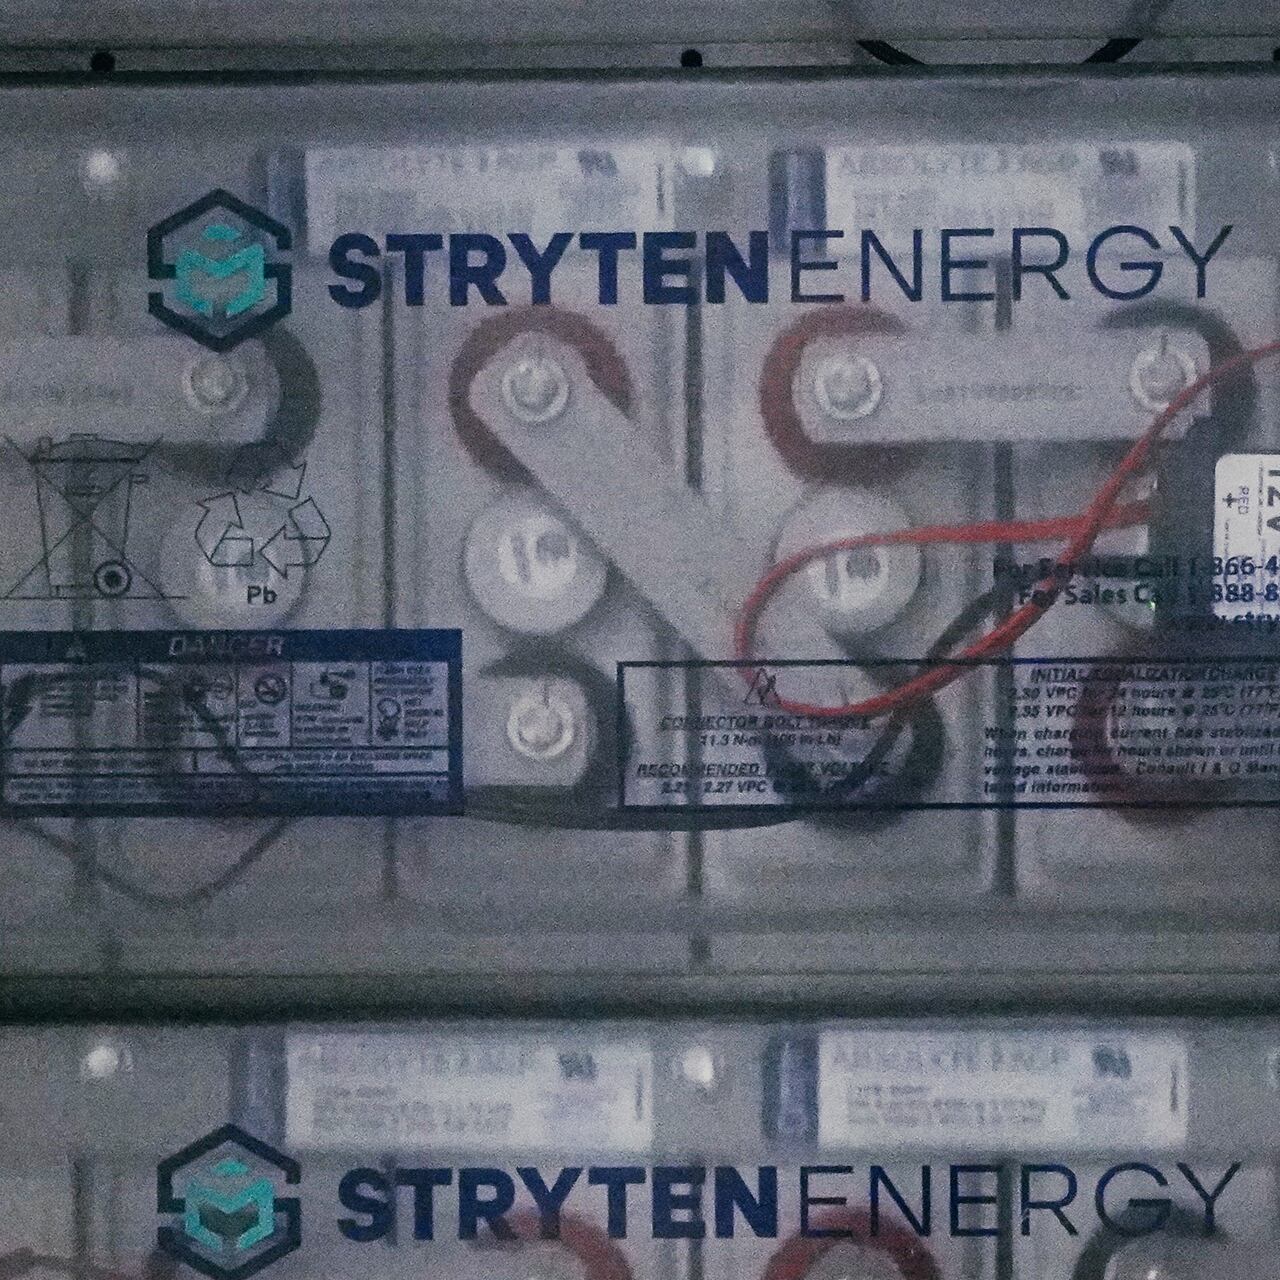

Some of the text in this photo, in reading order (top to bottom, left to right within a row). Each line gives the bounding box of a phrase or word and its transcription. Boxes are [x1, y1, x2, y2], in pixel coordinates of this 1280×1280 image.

[327, 224, 1234, 309] STRYTEN ENERGY
[247, 586, 278, 605] Pb
[1064, 583, 1127, 605] Sales
[342, 1161, 1243, 1242] STRYTEN ENERGY
